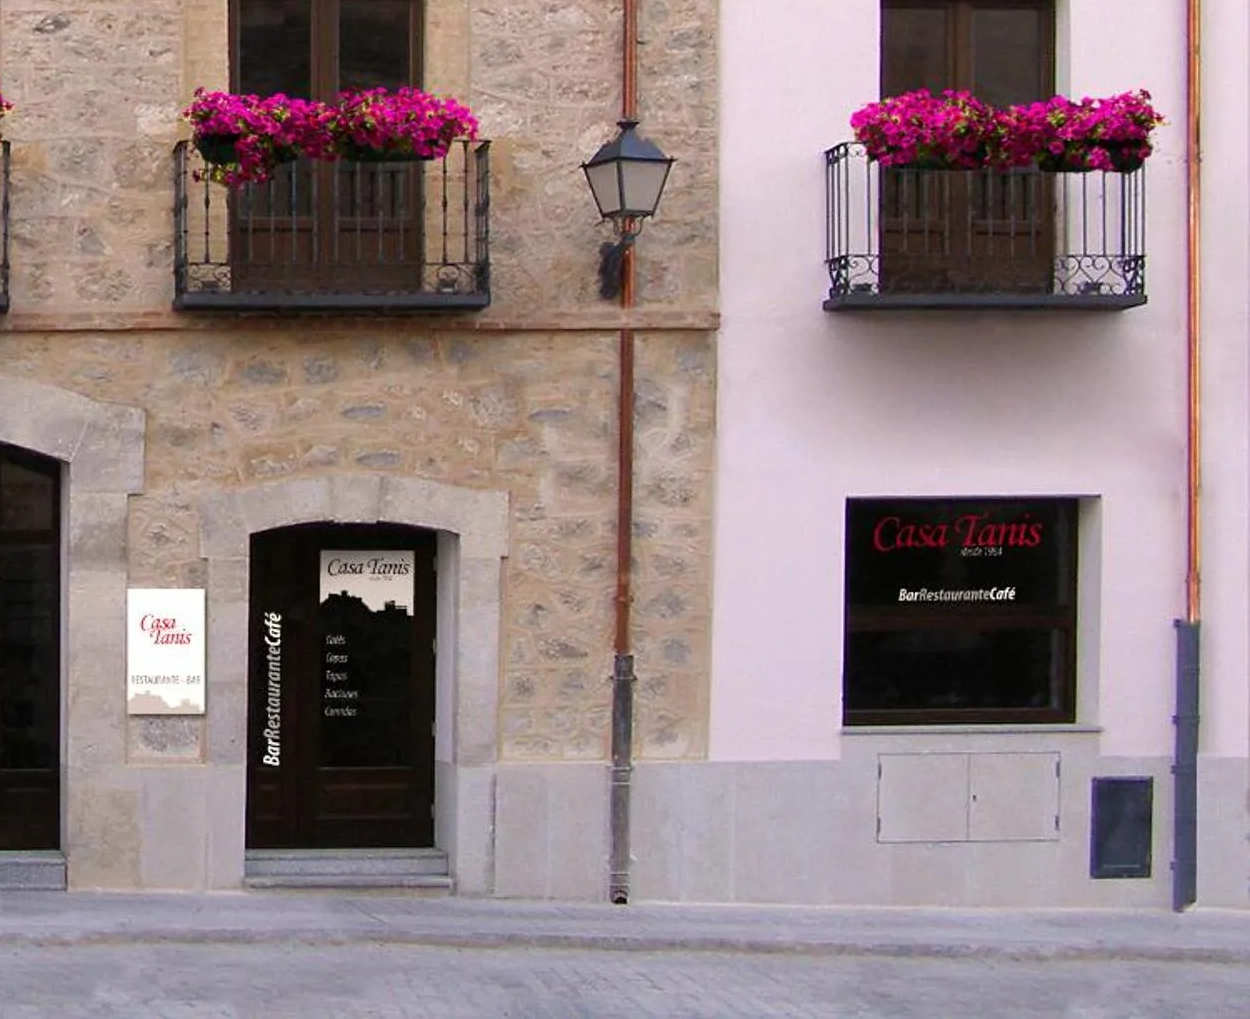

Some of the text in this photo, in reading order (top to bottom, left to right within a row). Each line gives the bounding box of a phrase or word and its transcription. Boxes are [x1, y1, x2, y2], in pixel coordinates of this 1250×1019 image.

[873, 511, 1043, 552] Casa Tanis
[328, 557, 410, 576] Casa Tanis
[898, 586, 1016, 602] BarRestauranteCafé
[139, 613, 177, 632] Casa
[149, 628, 193, 645] Tanis
[263, 611, 282, 766] BarRestauranteCafé
